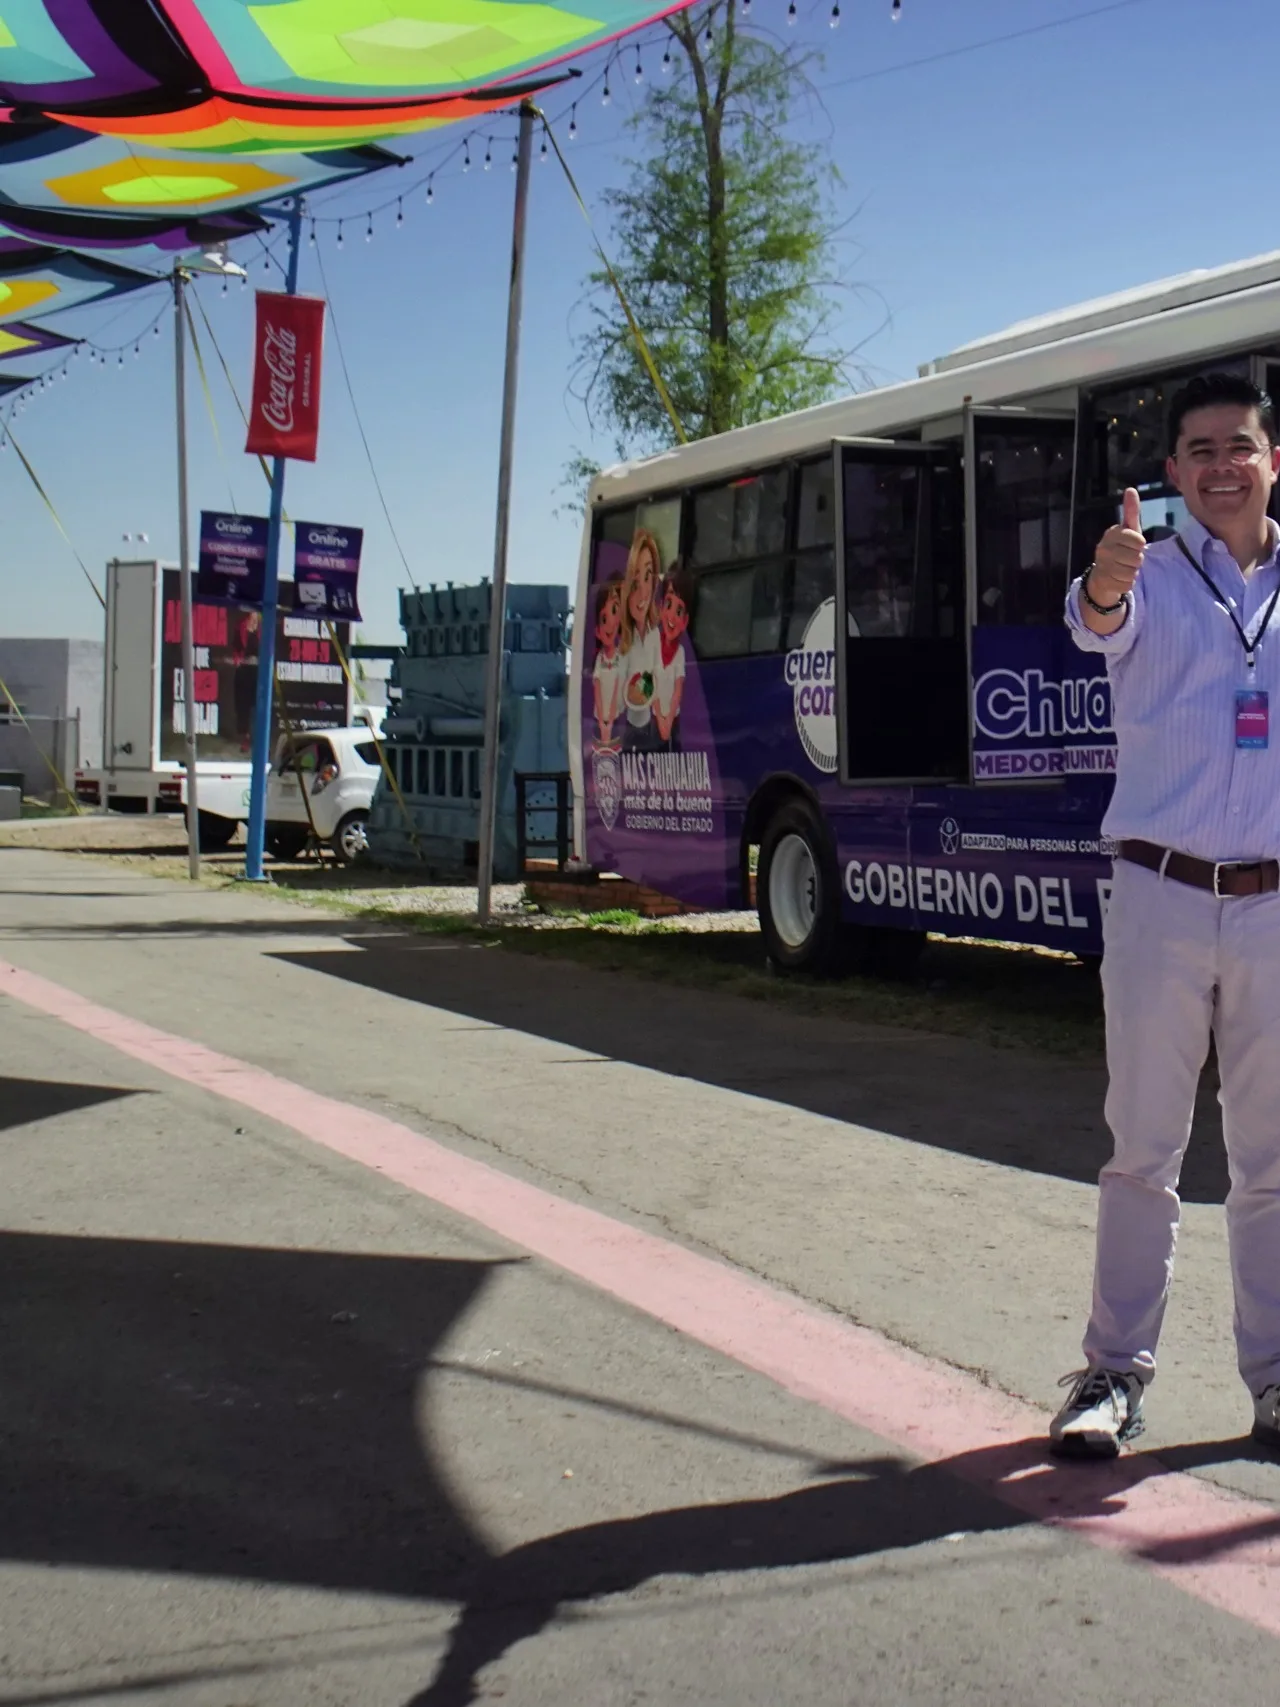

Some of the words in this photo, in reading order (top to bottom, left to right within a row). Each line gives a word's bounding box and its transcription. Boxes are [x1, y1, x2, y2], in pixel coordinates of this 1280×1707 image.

[261, 320, 296, 432] Coca-Cola
[302, 352, 311, 407] ORIGINAL
[215, 519, 253, 535] Online
[308, 531, 348, 547] Online
[622, 745, 646, 790] MÁS
[647, 751, 711, 791] CHIHUAHUA
[624, 790, 646, 809] más
[647, 791, 662, 811] de
[676, 792, 711, 813] bueno
[625, 814, 663, 830] GOBIERNO
[664, 815, 680, 831] DEL
[681, 817, 713, 833] ESTADO
[962, 835, 1004, 849] ADAPTADO
[1006, 836, 1028, 850] PARA
[1030, 838, 1076, 853] PERSONAS
[1079, 840, 1099, 853] CON
[845, 860, 1004, 919] GOBIERNO
[1014, 875, 1088, 928] DEL
